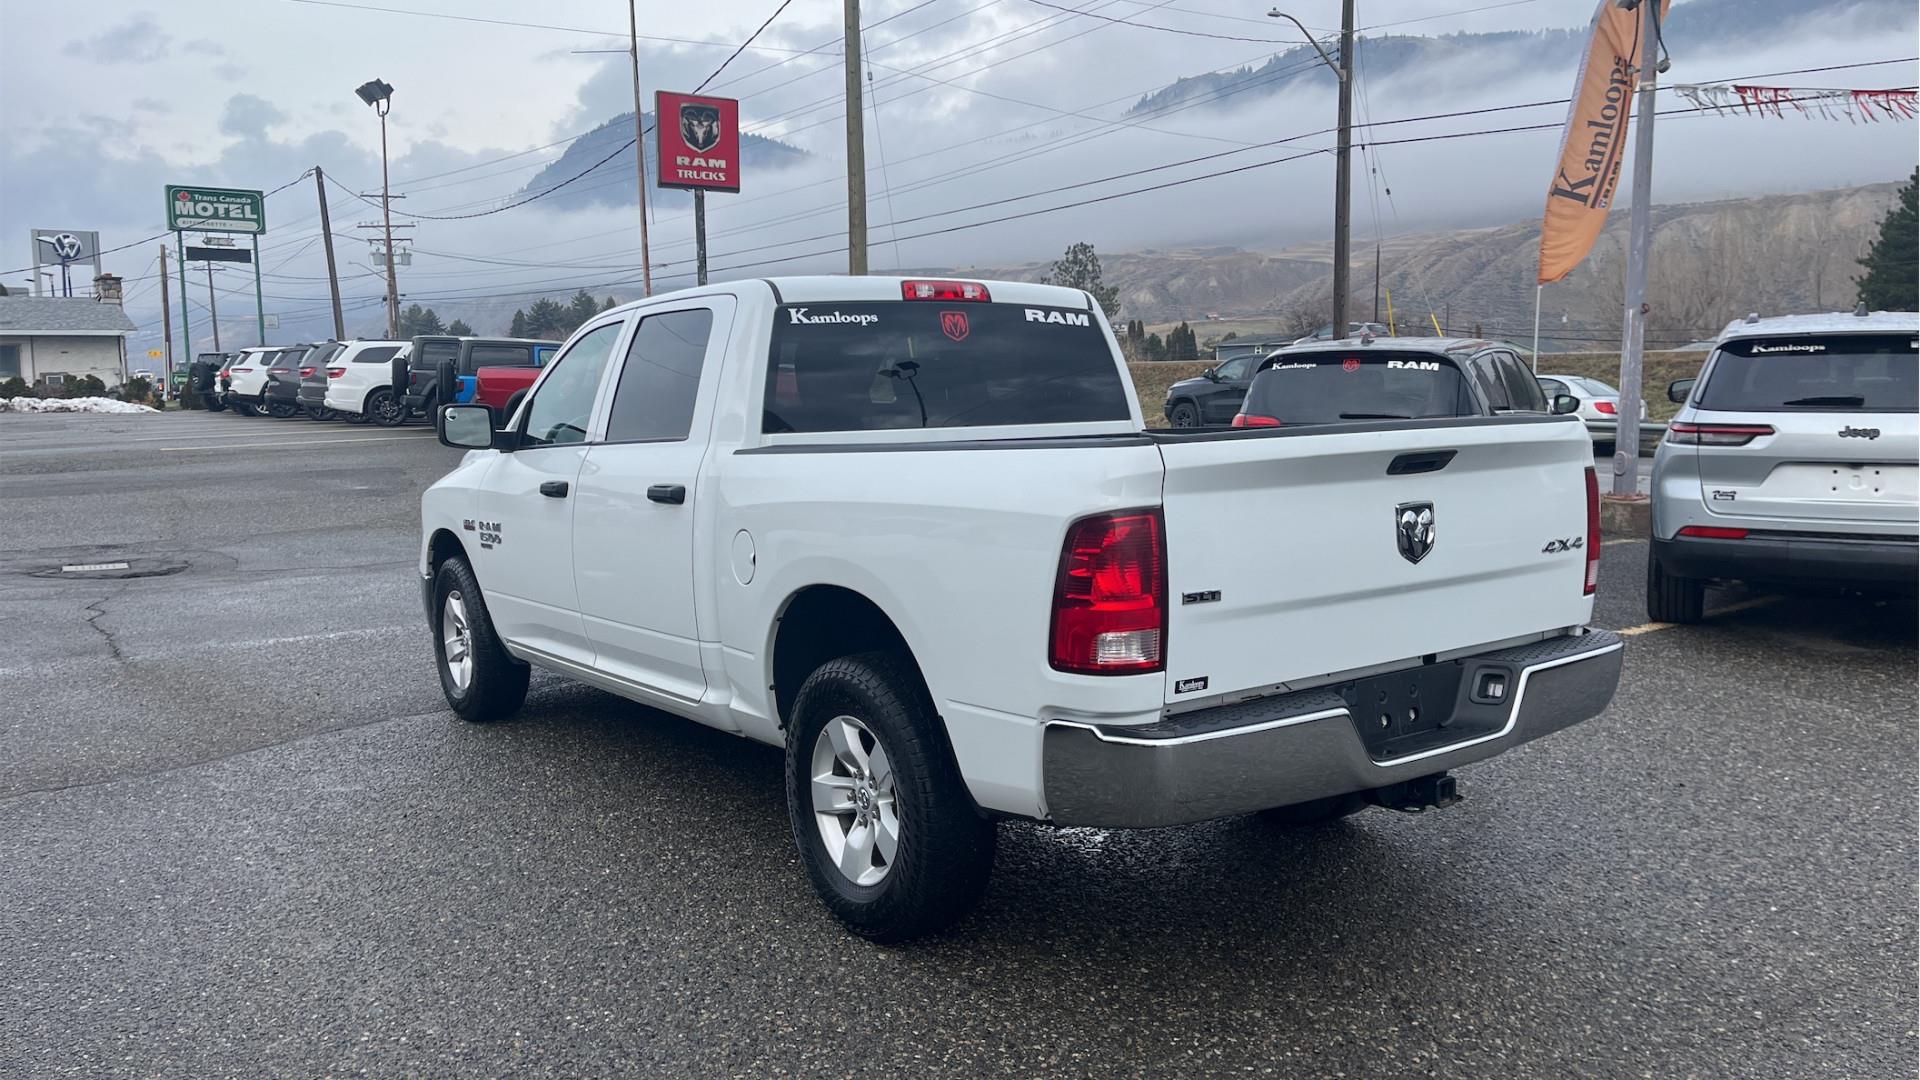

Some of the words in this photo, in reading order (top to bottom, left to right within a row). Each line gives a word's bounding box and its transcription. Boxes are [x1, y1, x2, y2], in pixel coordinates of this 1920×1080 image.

[1551, 55, 1629, 206] Kamloops
[676, 155, 726, 168] RAM
[676, 169, 726, 181] TRUCKS
[194, 194, 217, 202] Trans
[219, 195, 252, 203] Canada
[174, 200, 258, 219] MOTEL
[787, 307, 879, 326] Kamloops
[1024, 308, 1090, 327] RAM
[1751, 343, 1826, 353] Kamloops
[1271, 362, 1317, 371] Kamloops
[1387, 360, 1440, 371] RAM
[1838, 425, 1881, 440] Jeep
[1182, 590, 1222, 605] SLT
